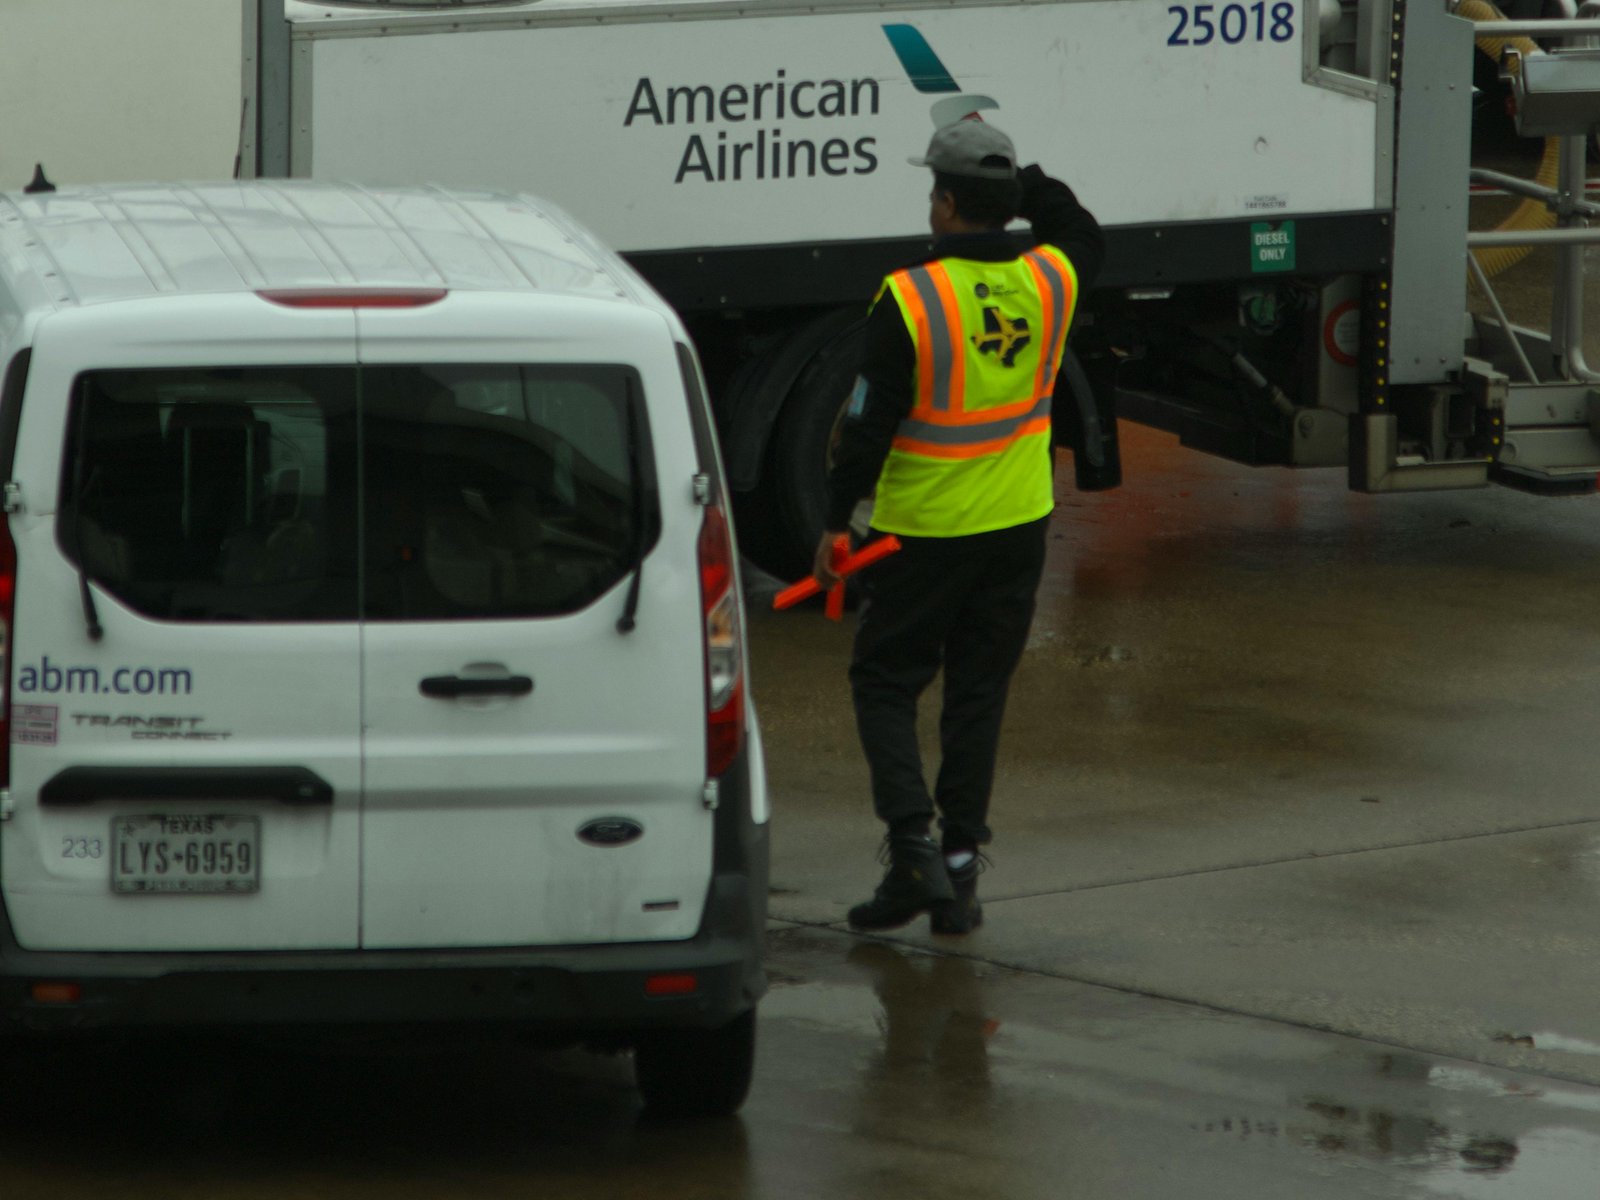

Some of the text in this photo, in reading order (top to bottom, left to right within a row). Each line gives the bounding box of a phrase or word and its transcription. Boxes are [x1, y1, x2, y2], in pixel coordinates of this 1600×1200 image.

[1167, 1, 1294, 47] 25018
[623, 69, 880, 127] American
[674, 129, 879, 184] Airlines
[1254, 231, 1290, 246] DIESEL
[1259, 248, 1286, 261] ONLY
[18, 656, 192, 694] abm.com
[71, 713, 204, 728] TRANSIT
[160, 820, 215, 835] TEXAS
[62, 838, 103, 859] 233
